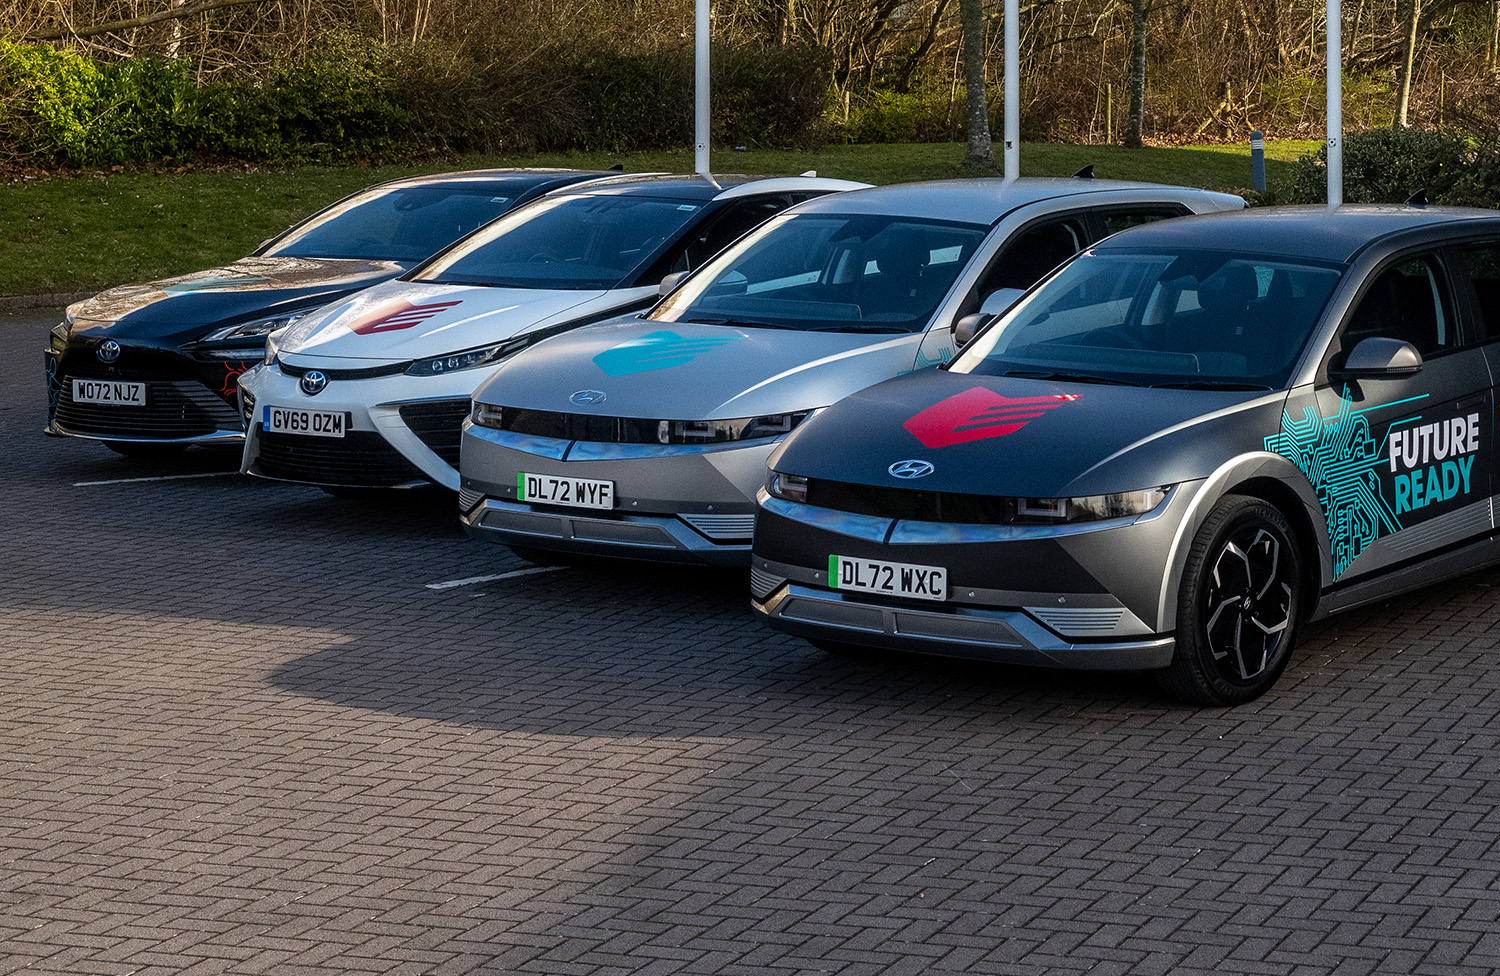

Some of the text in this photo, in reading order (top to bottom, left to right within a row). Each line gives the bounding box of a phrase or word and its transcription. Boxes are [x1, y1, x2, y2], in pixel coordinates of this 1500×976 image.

[114, 384, 140, 402] NJZ
[273, 410, 342, 433] GV69 OZM
[1389, 412, 1479, 473] FUTURE
[528, 477, 610, 505] DL72 WYF
[1394, 454, 1476, 516] READY
[842, 560, 943, 595] DL72 WXC
